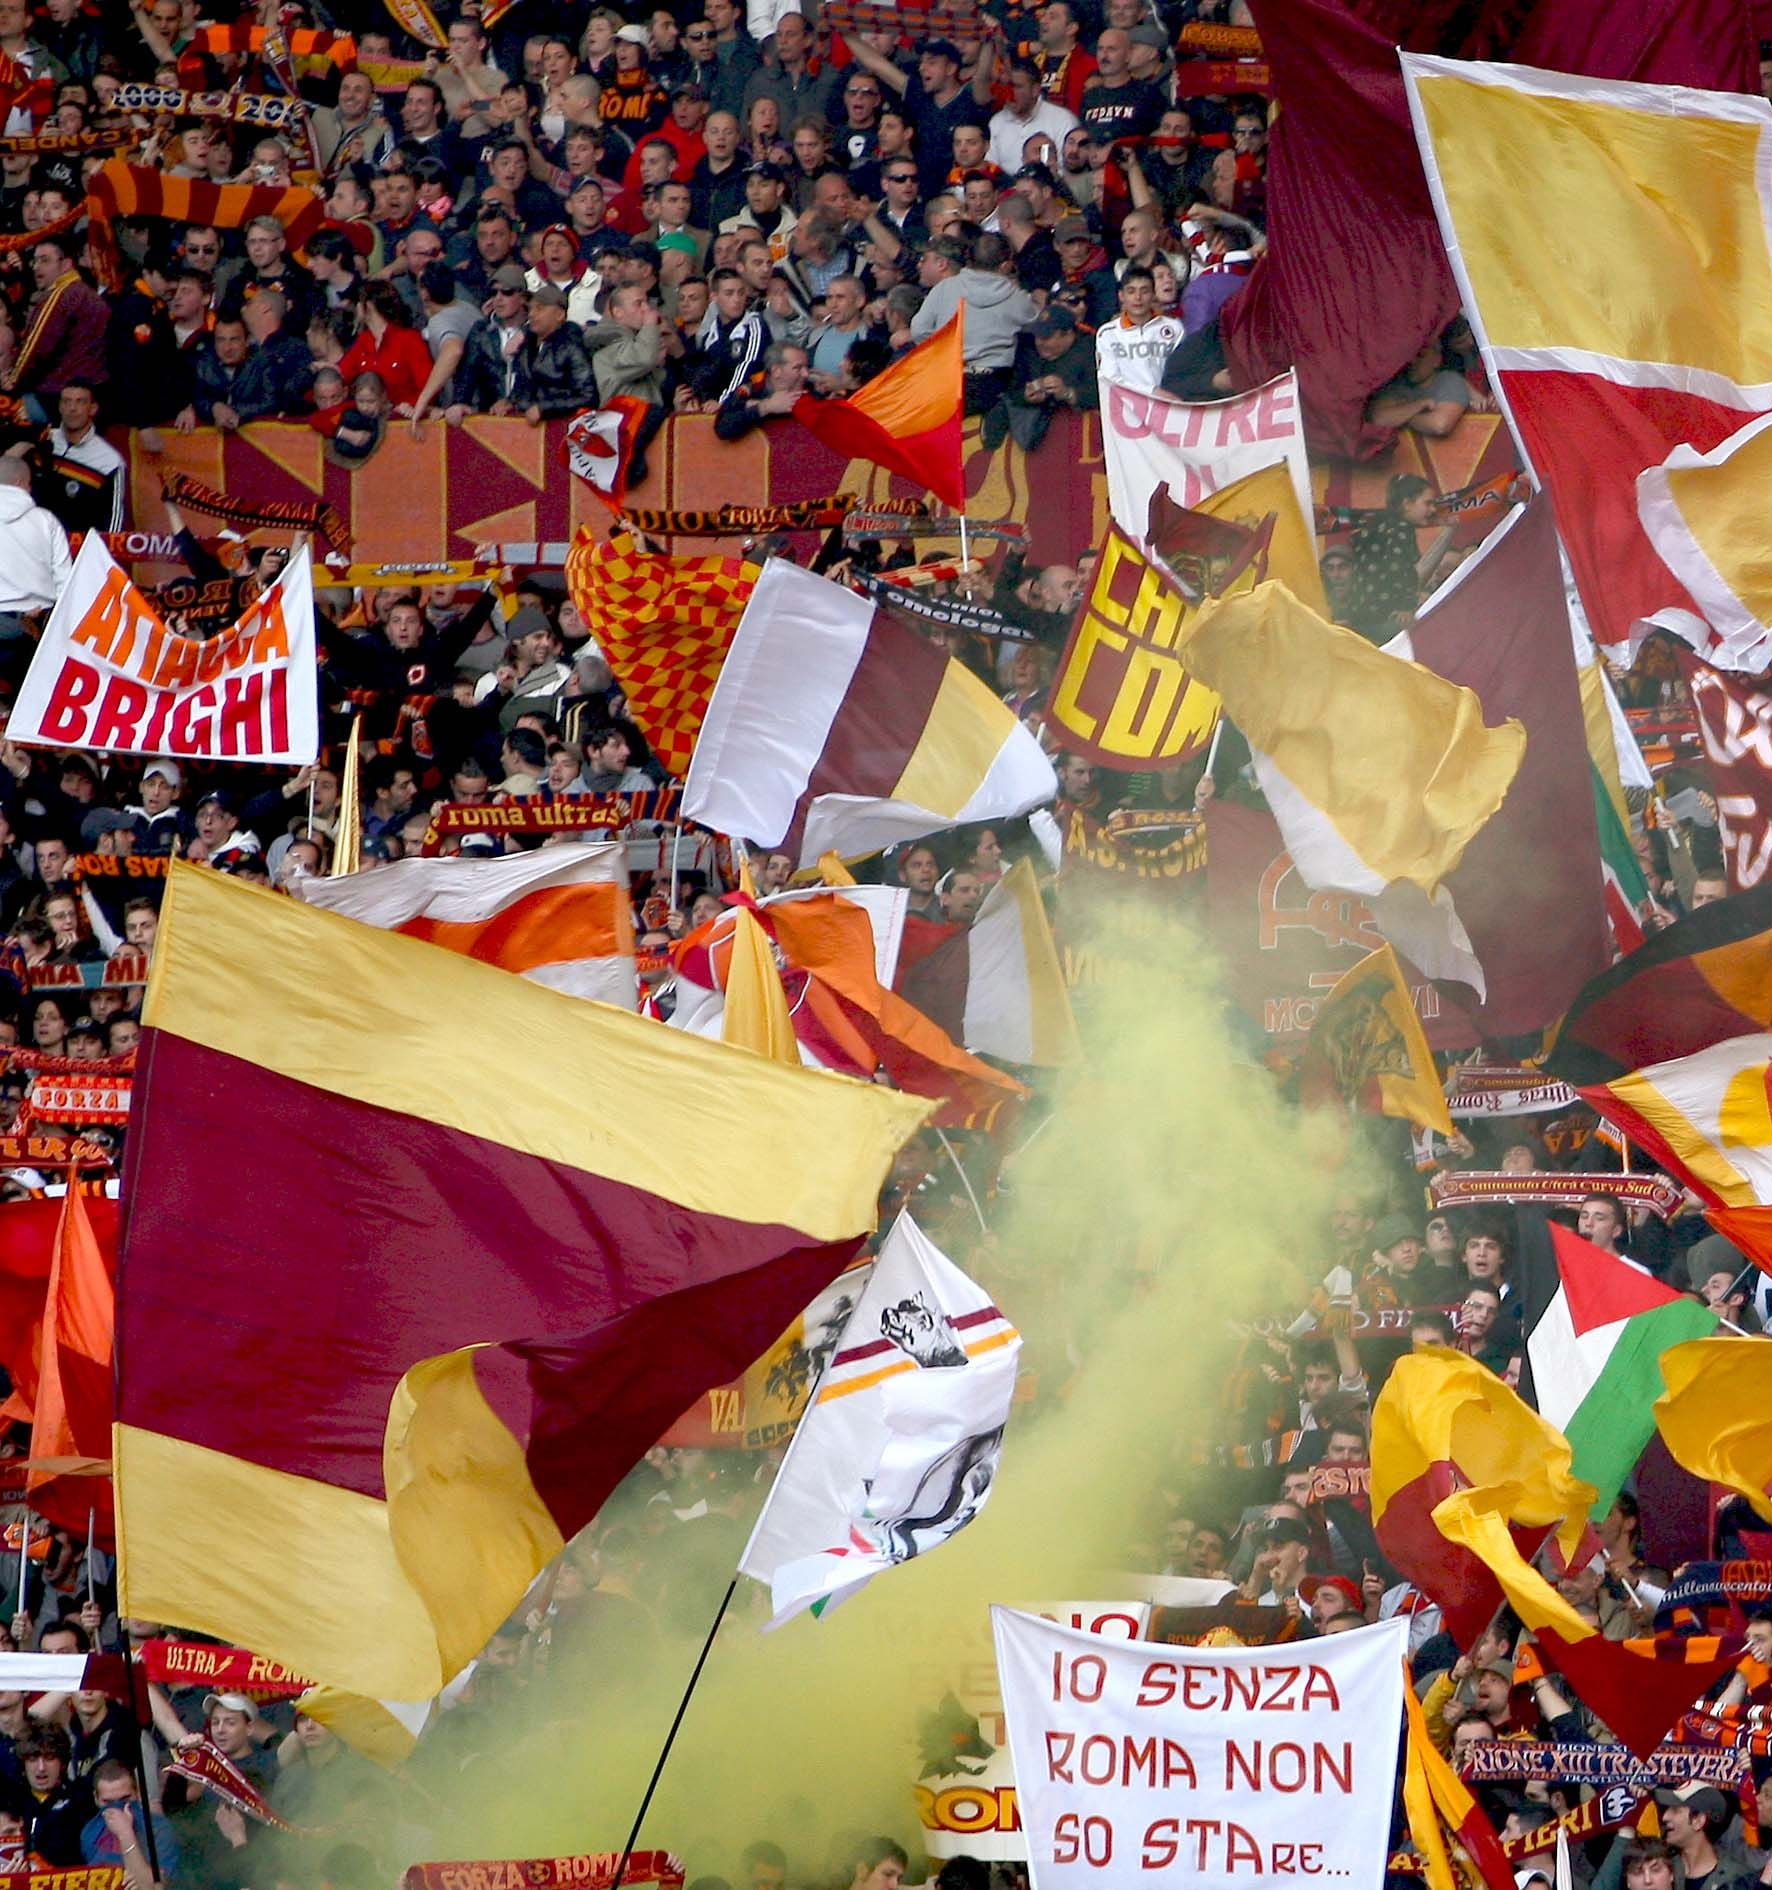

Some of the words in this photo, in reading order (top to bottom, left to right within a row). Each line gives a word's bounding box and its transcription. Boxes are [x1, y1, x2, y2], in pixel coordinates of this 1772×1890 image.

[1104, 374, 1297, 446] OLTRE
[71, 566, 289, 689] ATTACCA
[38, 656, 290, 757] BRIGHI
[447, 802, 526, 827] roma
[39, 1089, 118, 1109] FORZA
[1458, 1176, 1535, 1194] Commando
[1580, 1178, 1623, 1193] Curva
[1625, 1180, 1656, 1198] Sud
[165, 1645, 216, 1676] ULTRA
[1052, 1650, 1109, 1704] IO
[1135, 1661, 1342, 1712] SENZA
[1044, 1730, 1198, 1790] ROMA
[1224, 1739, 1354, 1794] NON
[1473, 1747, 1547, 1772] RIONE
[1550, 1752, 1593, 1778] XIII
[1052, 1812, 1114, 1868] SO
[440, 1861, 525, 1890] FORZA
